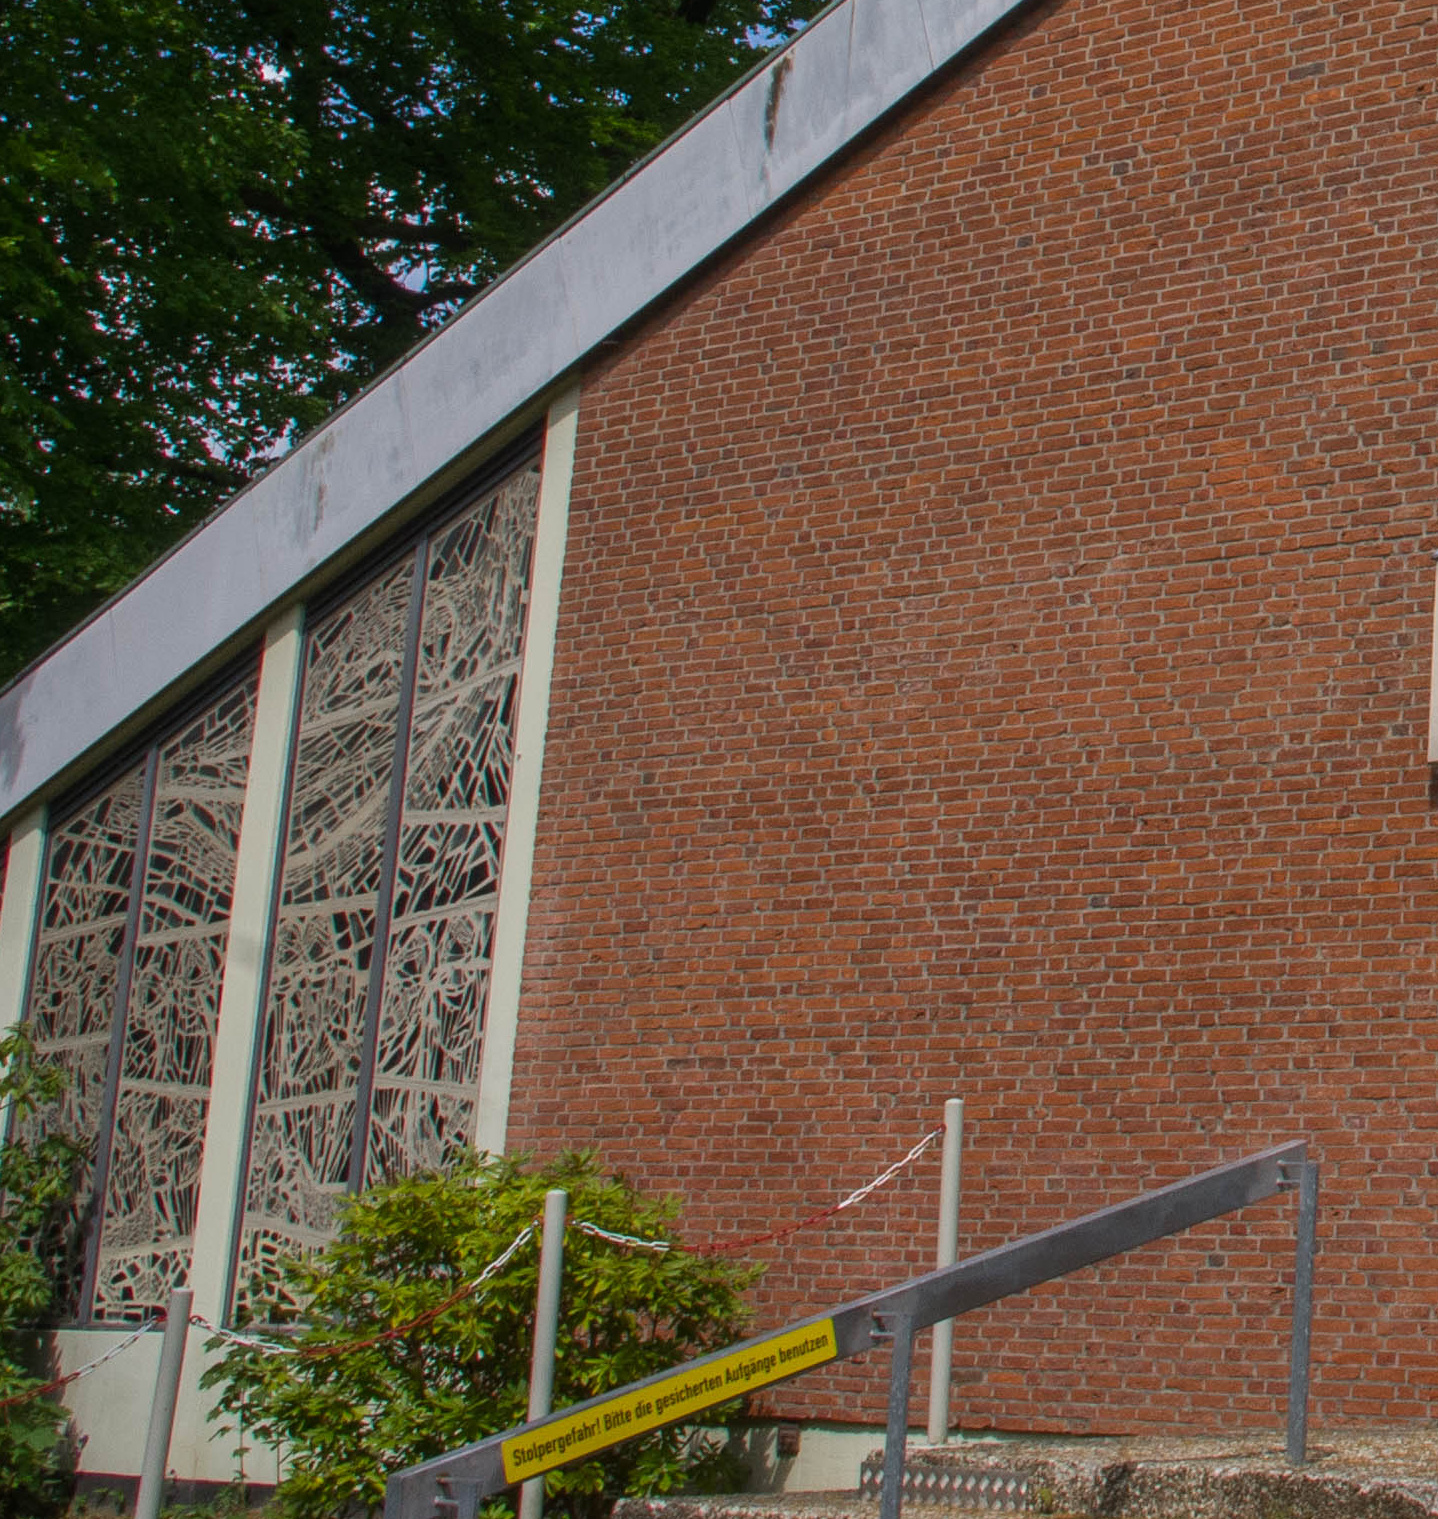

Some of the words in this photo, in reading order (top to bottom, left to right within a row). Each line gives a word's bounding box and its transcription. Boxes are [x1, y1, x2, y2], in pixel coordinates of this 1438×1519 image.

[513, 1417, 601, 1467] Stolpergefahr!
[603, 1409, 632, 1431] Bitte
[635, 1399, 653, 1419] die
[655, 1373, 723, 1415] gesicherten
[725, 1353, 777, 1384] Aufgänge
[778, 1333, 829, 1364] benutzen
